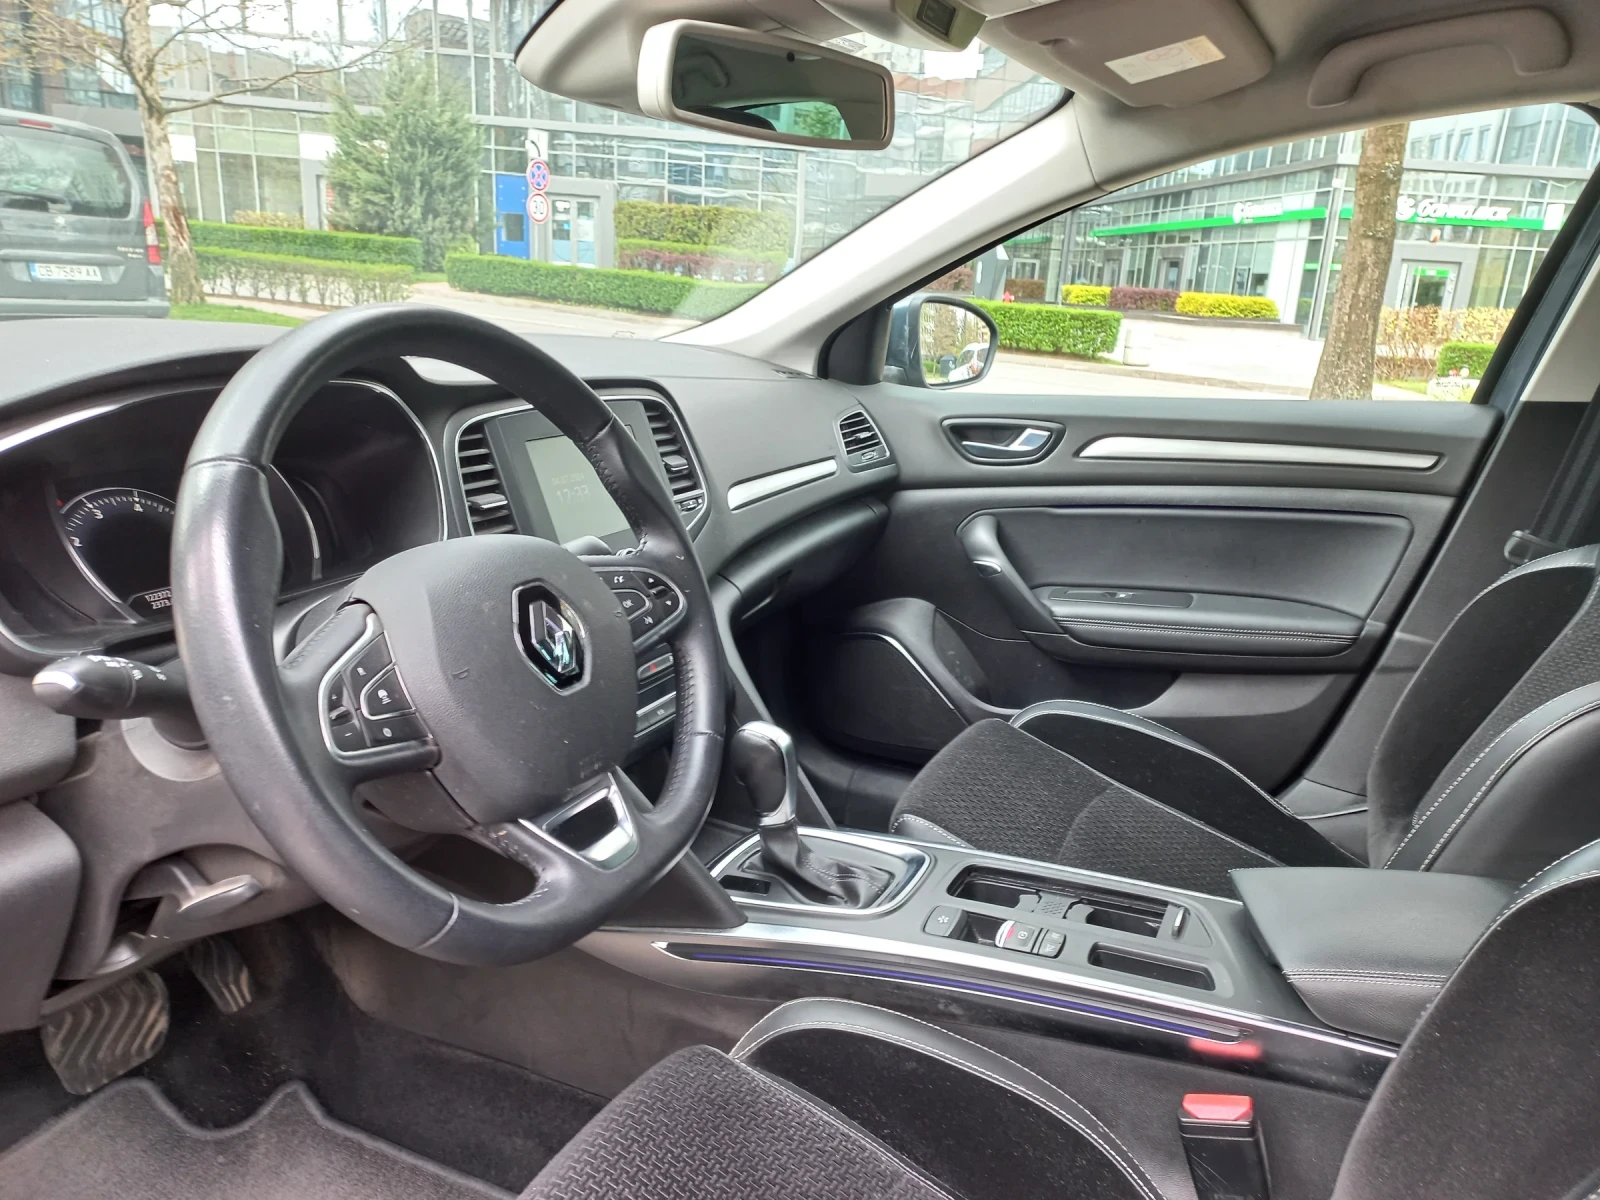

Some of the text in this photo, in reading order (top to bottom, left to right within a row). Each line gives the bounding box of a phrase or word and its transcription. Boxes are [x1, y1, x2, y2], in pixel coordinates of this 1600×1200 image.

[532, 200, 545, 215] 30
[92, 508, 103, 519] 3
[70, 536, 83, 547] 2
